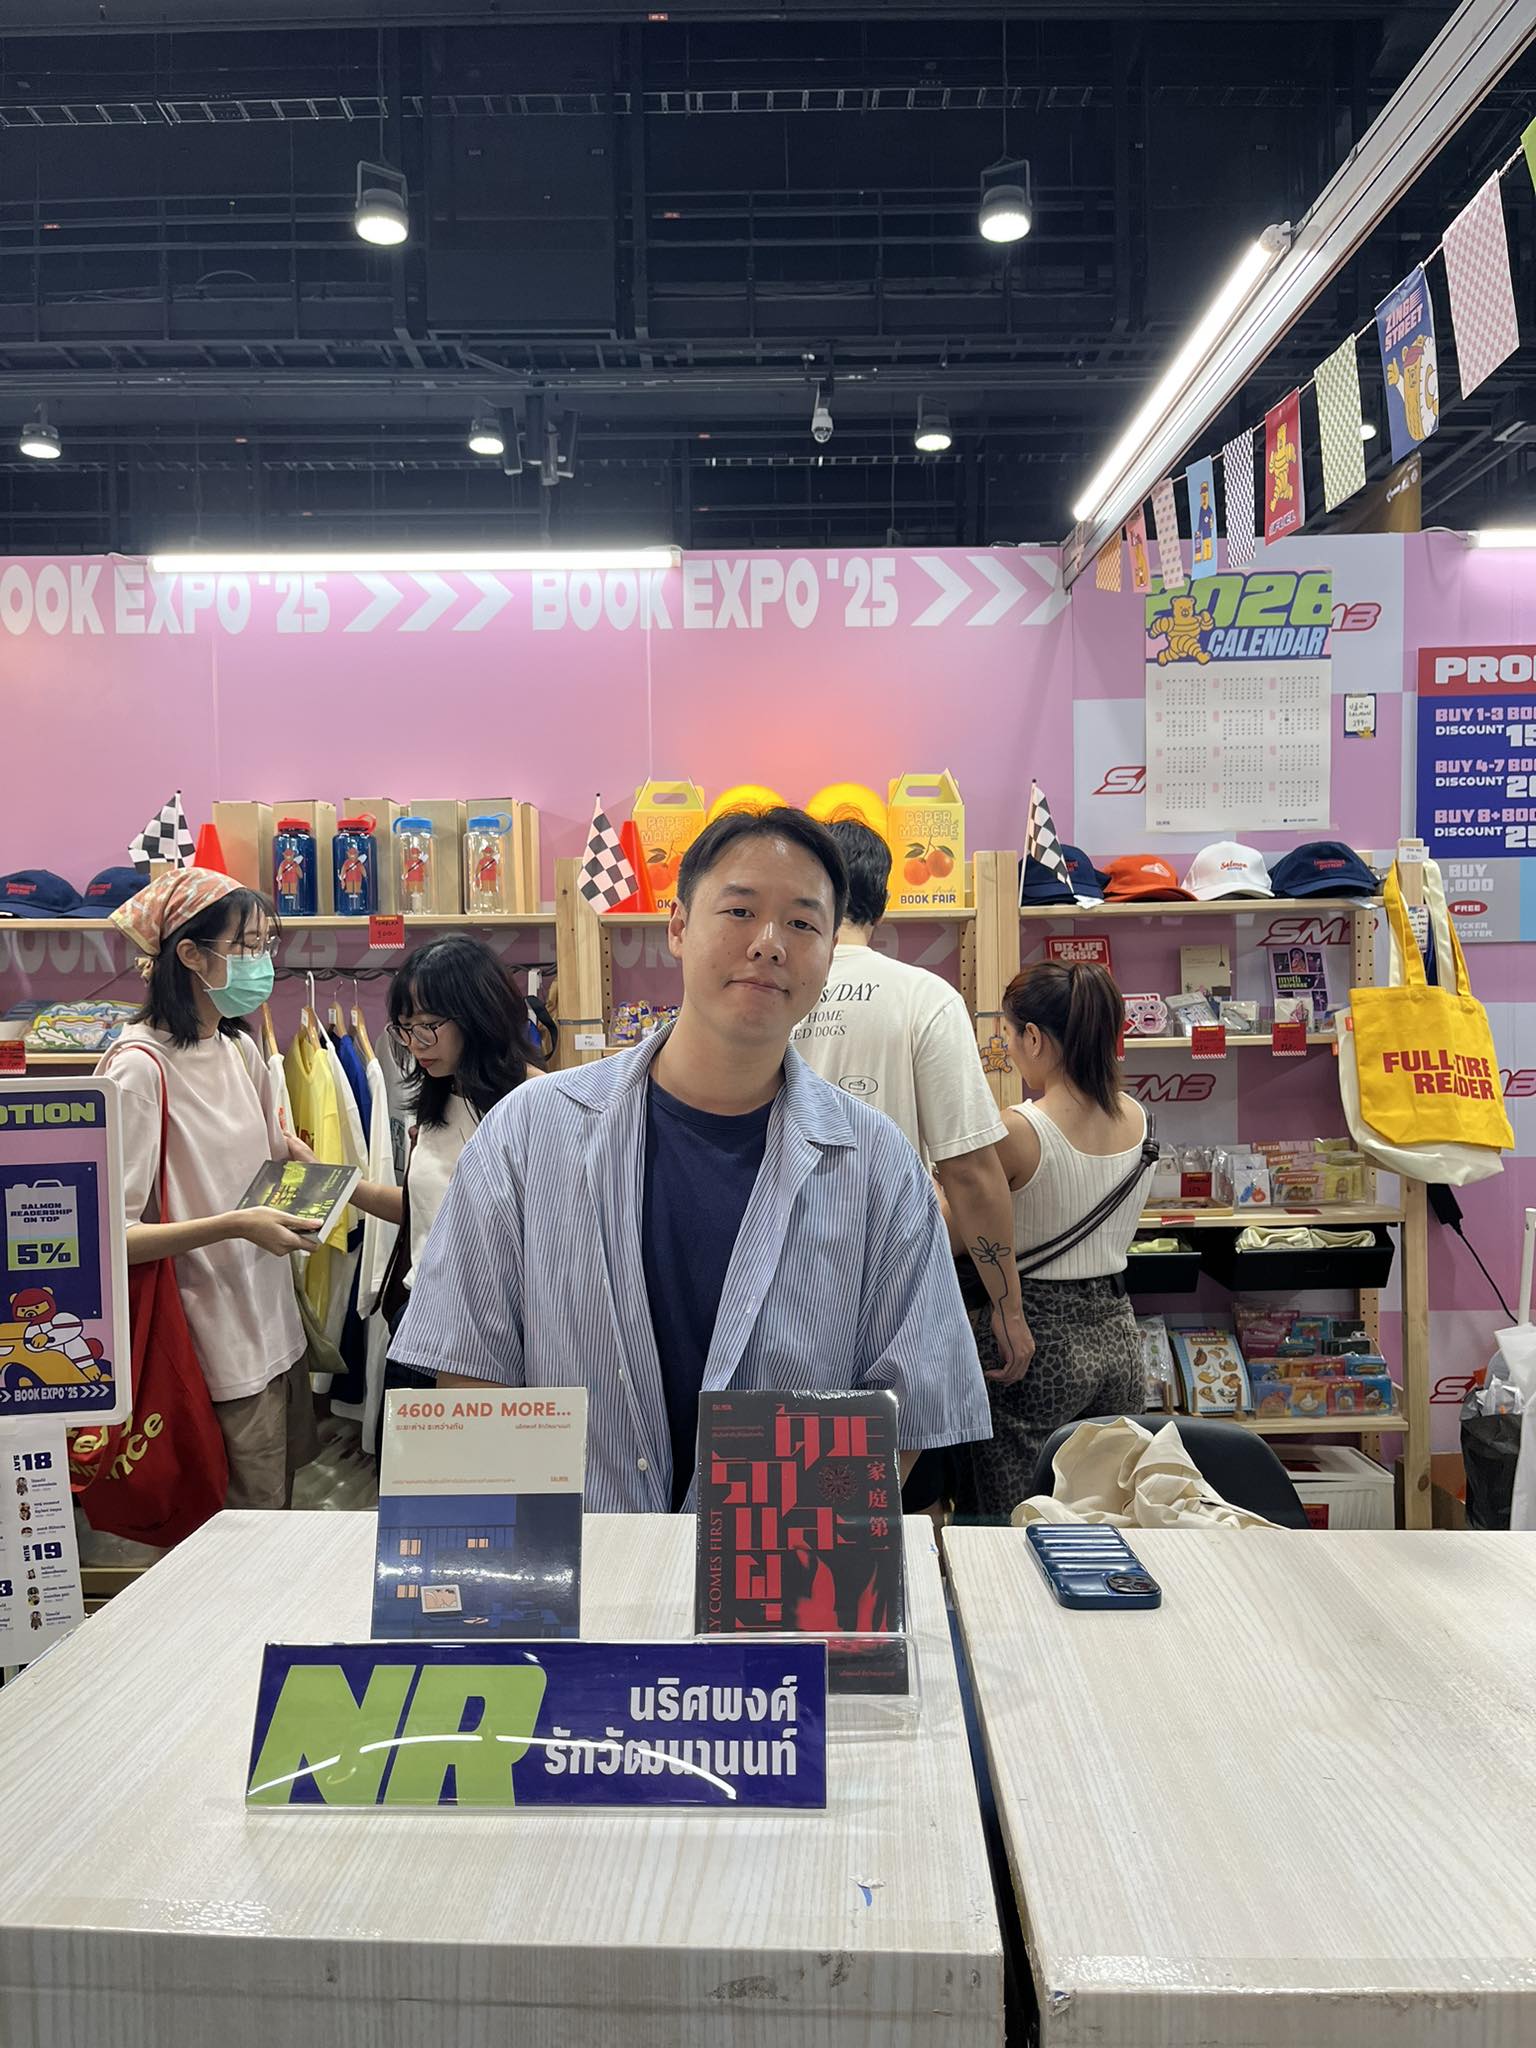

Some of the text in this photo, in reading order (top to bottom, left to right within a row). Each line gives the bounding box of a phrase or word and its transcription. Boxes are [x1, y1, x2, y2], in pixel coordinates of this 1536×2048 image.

[1384, 303, 1423, 352] STREET
[115, 565, 252, 635] EXPO
[257, 574, 331, 633] '25
[532, 557, 899, 631] BOOK EXPO '25
[1146, 573, 1332, 628] 2026
[1207, 627, 1328, 658] CALENDAR
[1435, 654, 1536, 684] PRO
[1435, 706, 1536, 723] BUY 1-3 BO
[1435, 724, 1504, 736] DISCOUNT
[1435, 758, 1536, 774] BUY 4-7 BO
[1092, 765, 1146, 795] S
[1435, 776, 1504, 787] DISCOUNT
[904, 810, 952, 824] PAPER
[1434, 809, 1475, 824] BUY
[1434, 826, 1504, 837] DISCOUNT
[1448, 863, 1488, 878] BUY
[900, 894, 957, 904] BOOK FAIR
[1454, 904, 1481, 912] FREE
[1256, 917, 1379, 947] SM
[1053, 942, 1103, 952] BIZ-LIFE
[1060, 951, 1099, 961] CRISIS
[807, 1010, 845, 1023] HOME
[790, 1025, 847, 1041] ED DOGS
[1415, 1072, 1496, 1101] READER
[10, 1209, 73, 1217] READERSHIP
[21, 1202, 62, 1210] SALMON
[17, 1242, 71, 1265] 5%
[14, 1386, 79, 1402] BOOK EXPO '25
[1430, 1376, 1476, 1404] S
[396, 1401, 571, 1418] 4600 AND MORE...
[22, 1452, 53, 1471] 18
[867, 1460, 891, 1551] 家庭第一
[710, 1510, 722, 1552] FIRST
[23, 1541, 62, 1562] SUN 19
[709, 1556, 722, 1614] COMES
[630, 1675, 798, 1722] นริศพงศ์
[249, 1664, 547, 1806] NR
